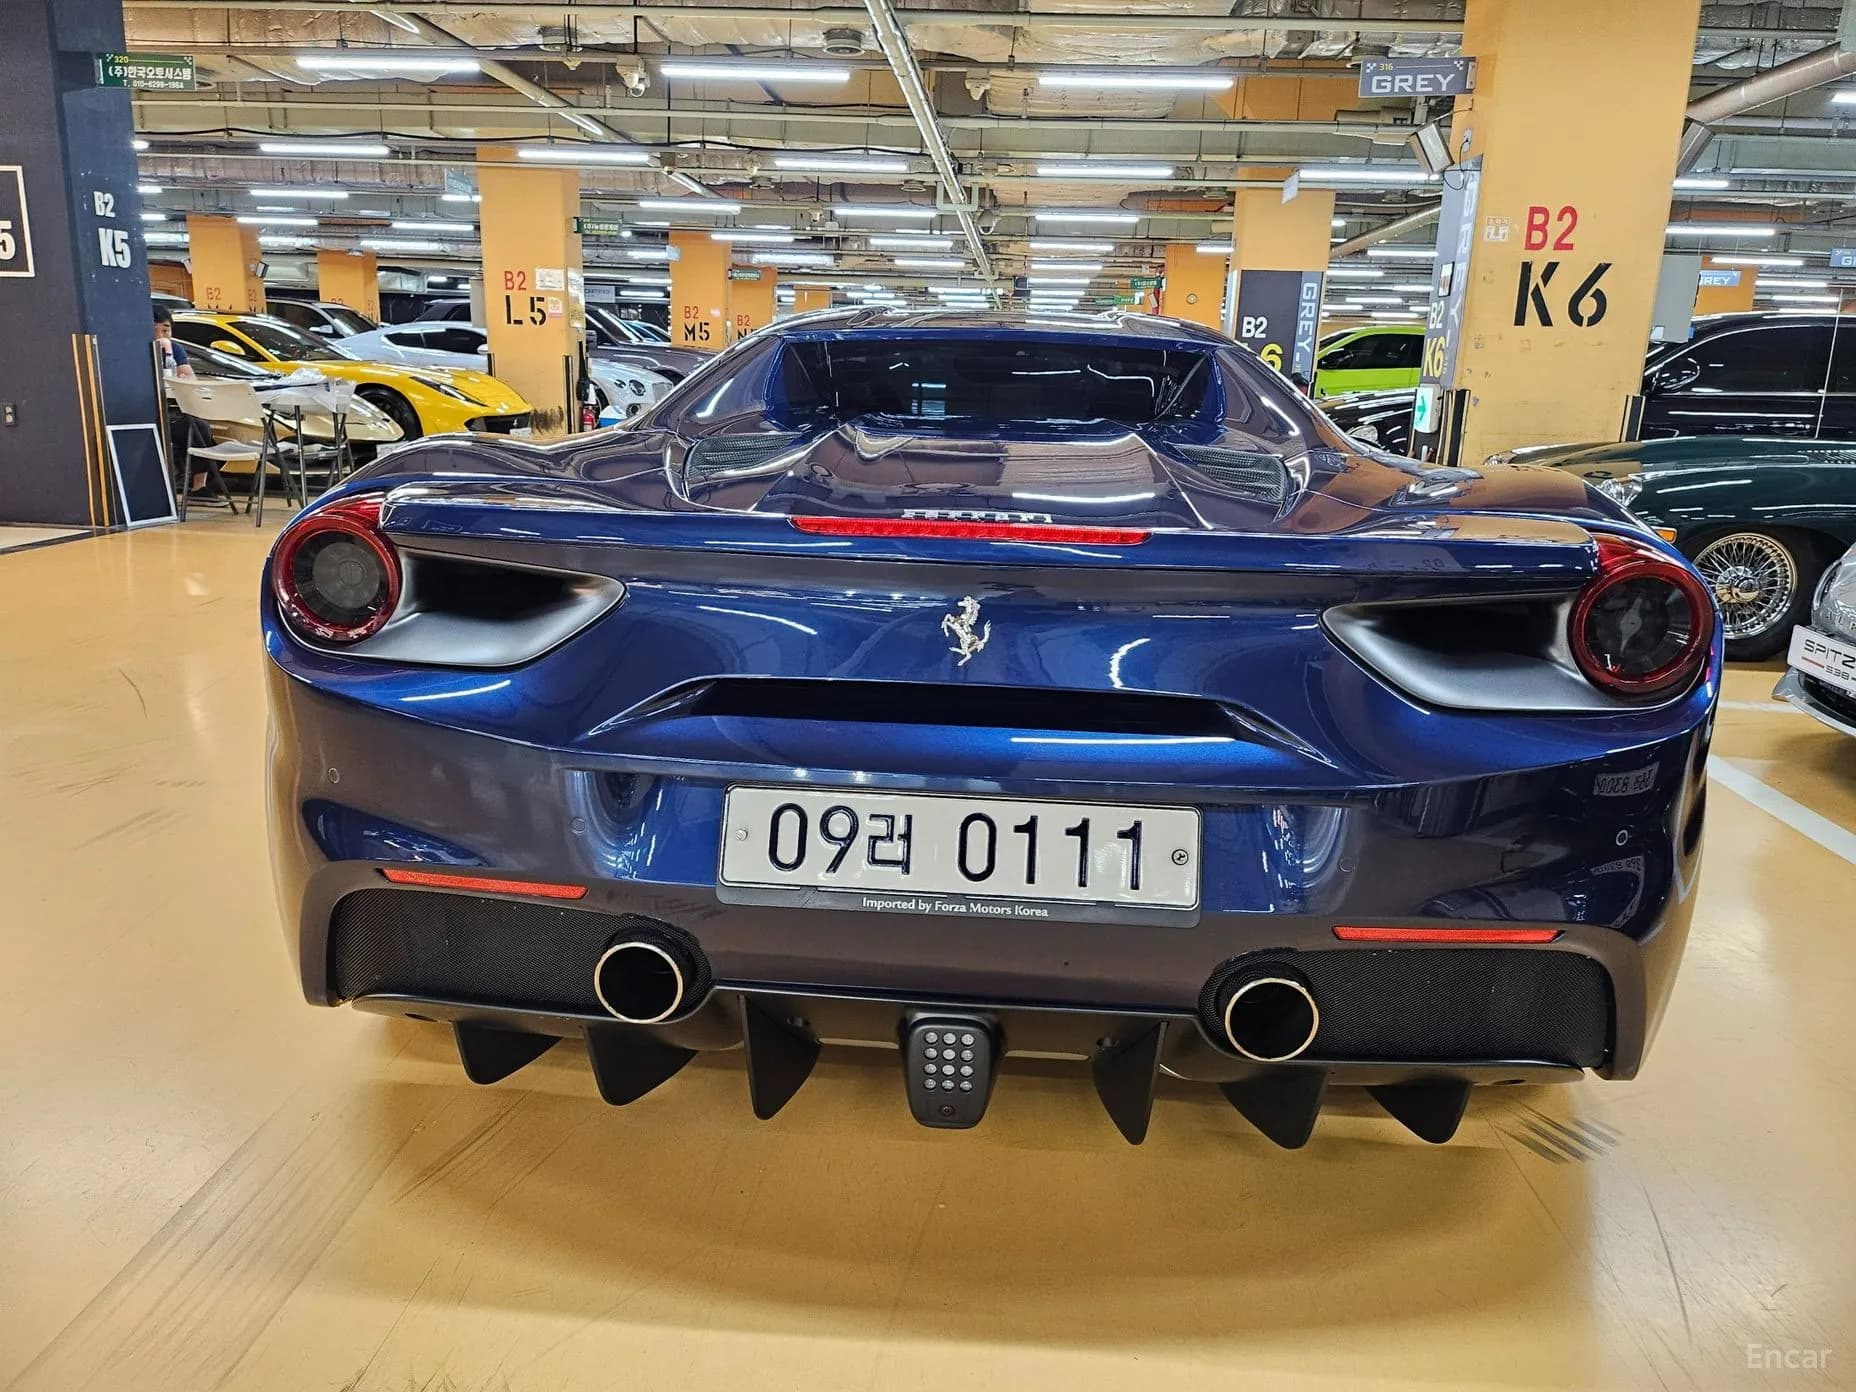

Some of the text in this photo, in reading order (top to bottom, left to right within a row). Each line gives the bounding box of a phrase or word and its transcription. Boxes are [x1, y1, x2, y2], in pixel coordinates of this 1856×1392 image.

[114, 56, 129, 64] 320
[1379, 63, 1393, 71] 316
[1371, 74, 1455, 93] GREY
[93, 191, 116, 218] B2
[1524, 206, 1578, 251] B2
[98, 227, 131, 268] K5
[504, 271, 526, 291] B2
[1514, 261, 1613, 327] K6
[505, 295, 546, 325] L5
[684, 306, 699, 319] B2
[737, 315, 751, 326] B2
[1297, 282, 1318, 353] GREY
[1429, 300, 1445, 329] B2
[684, 322, 710, 341] M5
[1242, 316, 1268, 338] B2
[1423, 336, 1446, 378] K6
[768, 803, 1144, 890] 09러 0111
[862, 897, 1049, 917] Imported by Forza Motors Korea
